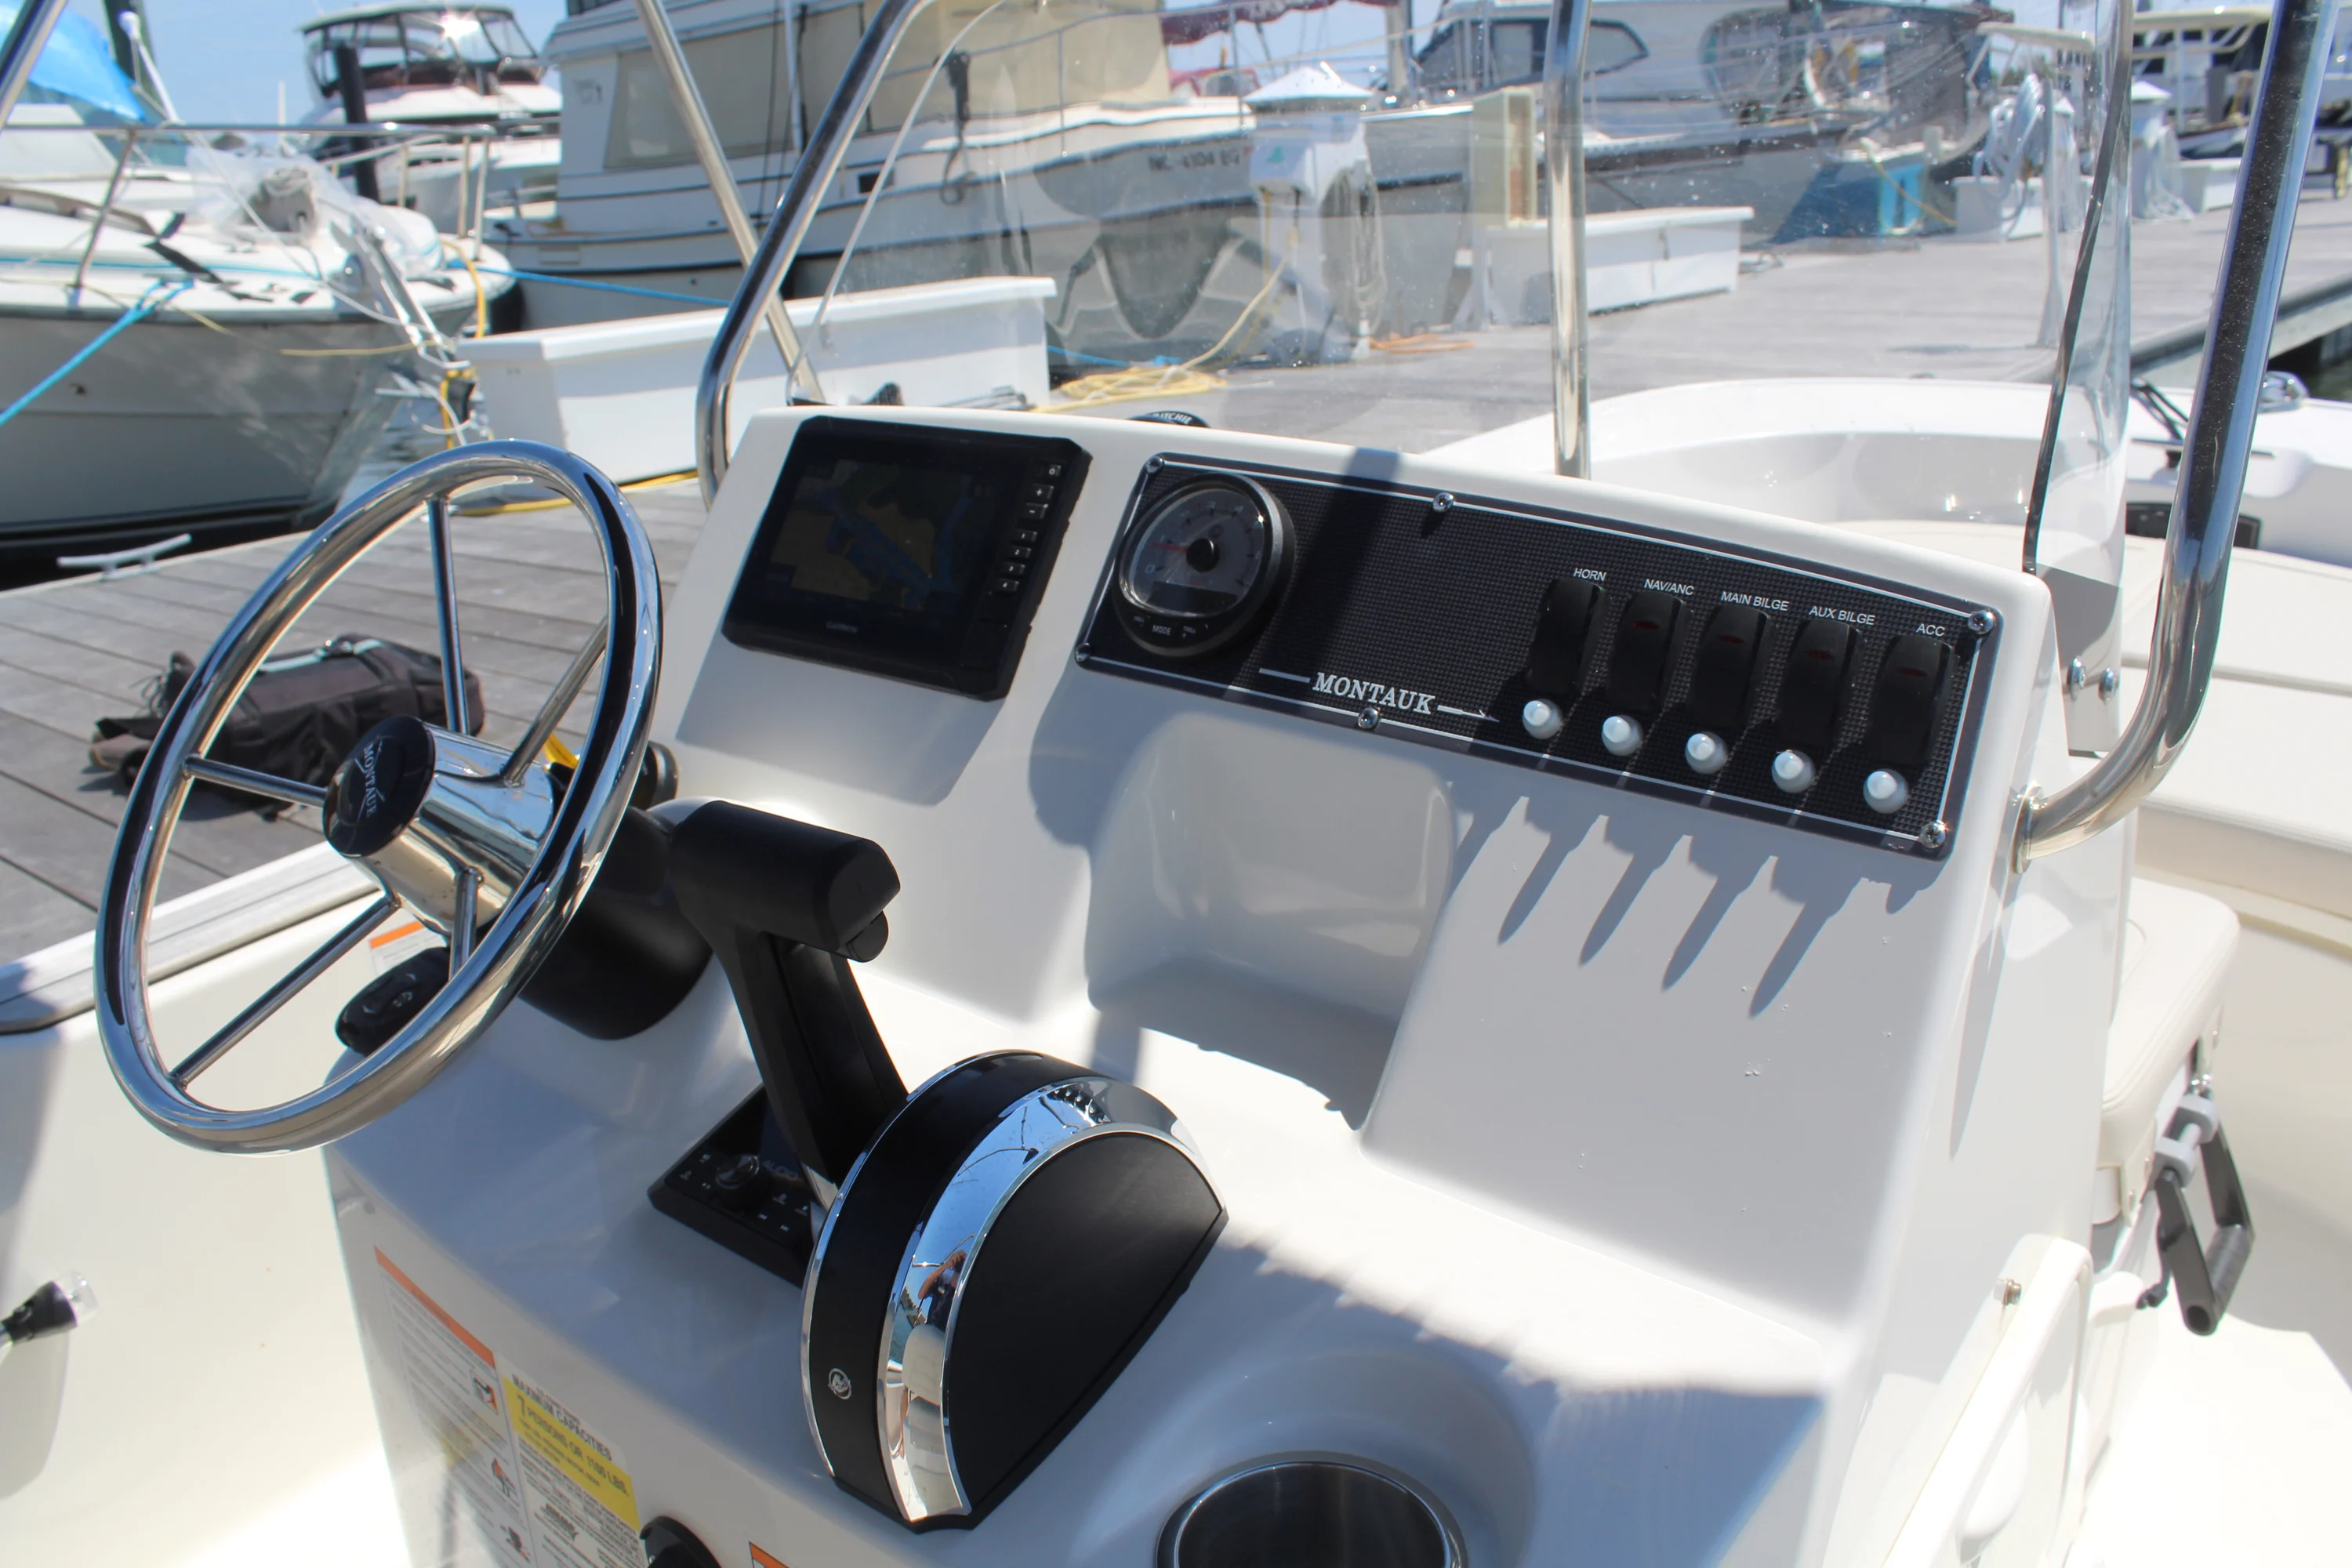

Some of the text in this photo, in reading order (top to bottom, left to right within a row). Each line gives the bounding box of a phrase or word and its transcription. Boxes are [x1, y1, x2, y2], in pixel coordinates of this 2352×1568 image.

[1573, 567, 1607, 582] HORN
[1644, 579, 1694, 596] NAV/ANC
[1721, 591, 1789, 612] MAIN BILGE
[1809, 605, 1876, 626] AUX BILGE
[1152, 624, 1172, 636] MODE
[1916, 622, 1945, 637] ACC
[1312, 672, 1436, 715] MONTAUK
[556, 1410, 612, 1461] CAPACITIES
